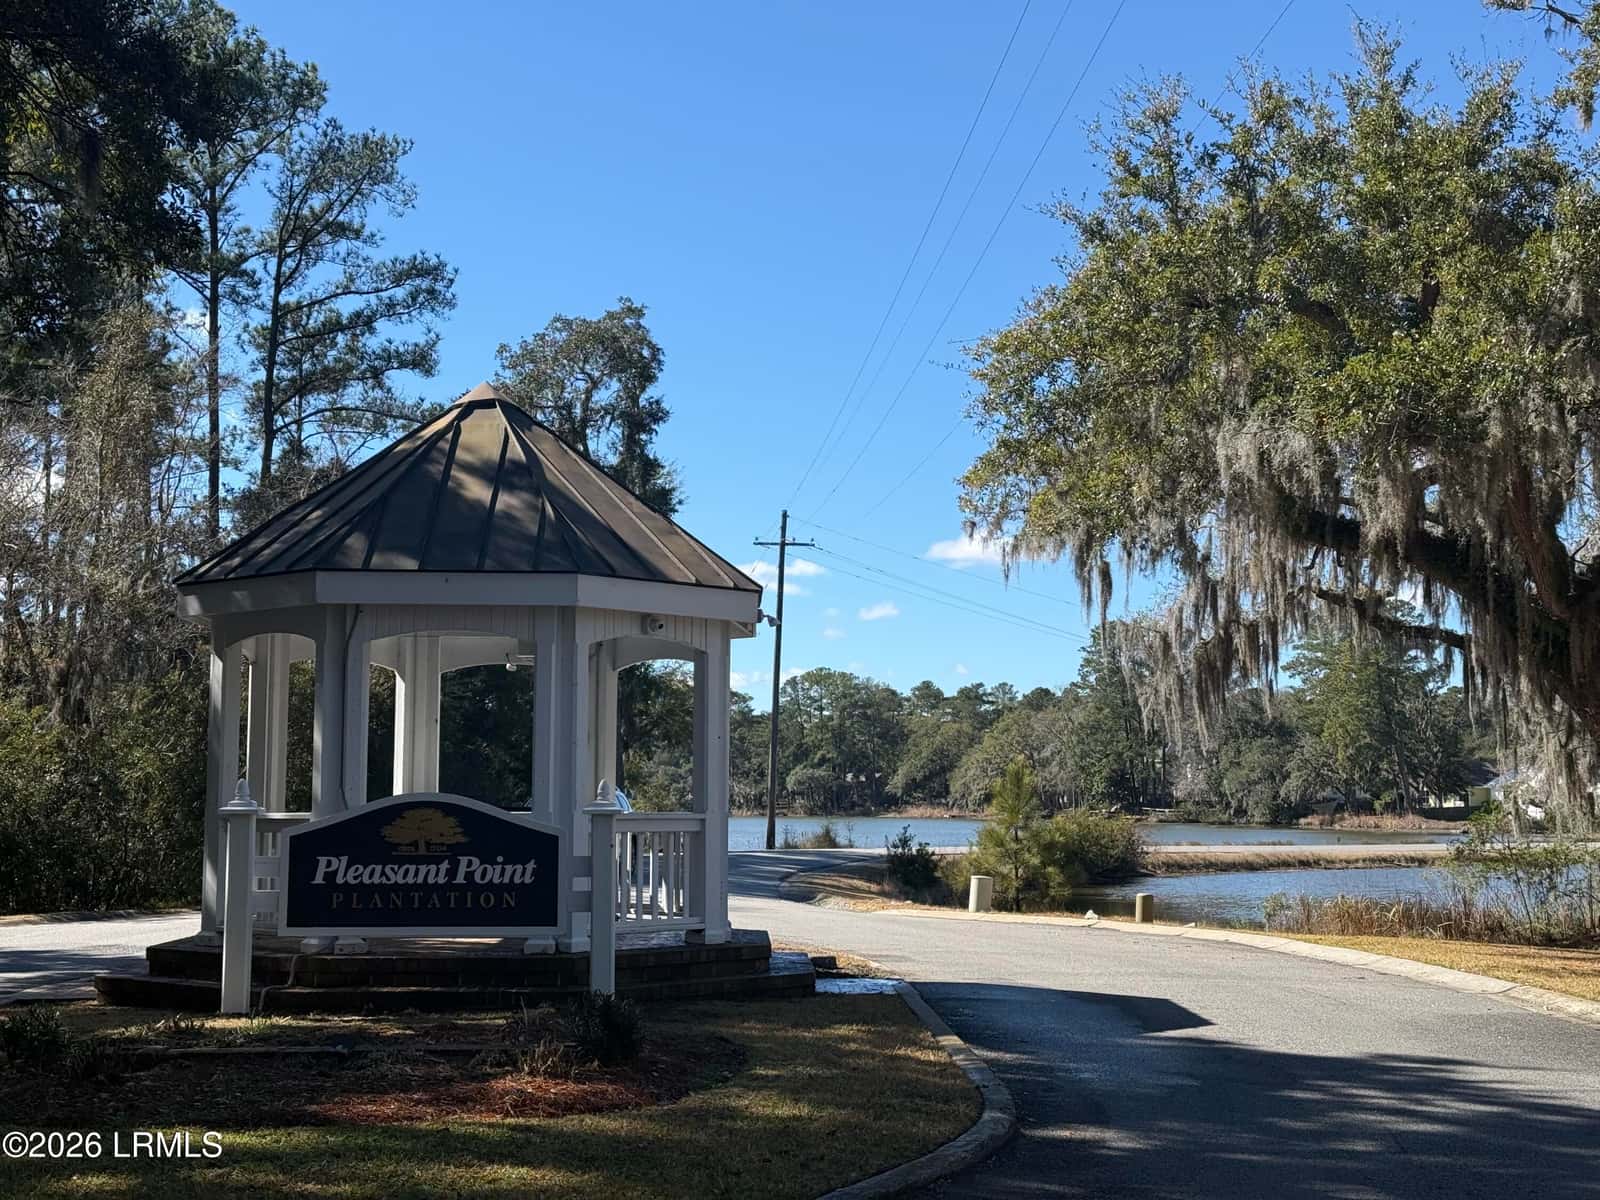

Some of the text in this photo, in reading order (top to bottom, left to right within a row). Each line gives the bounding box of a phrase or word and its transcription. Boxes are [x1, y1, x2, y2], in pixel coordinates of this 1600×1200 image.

[310, 855, 537, 884] Pleasant Point
[331, 892, 517, 909] PLANTATION
